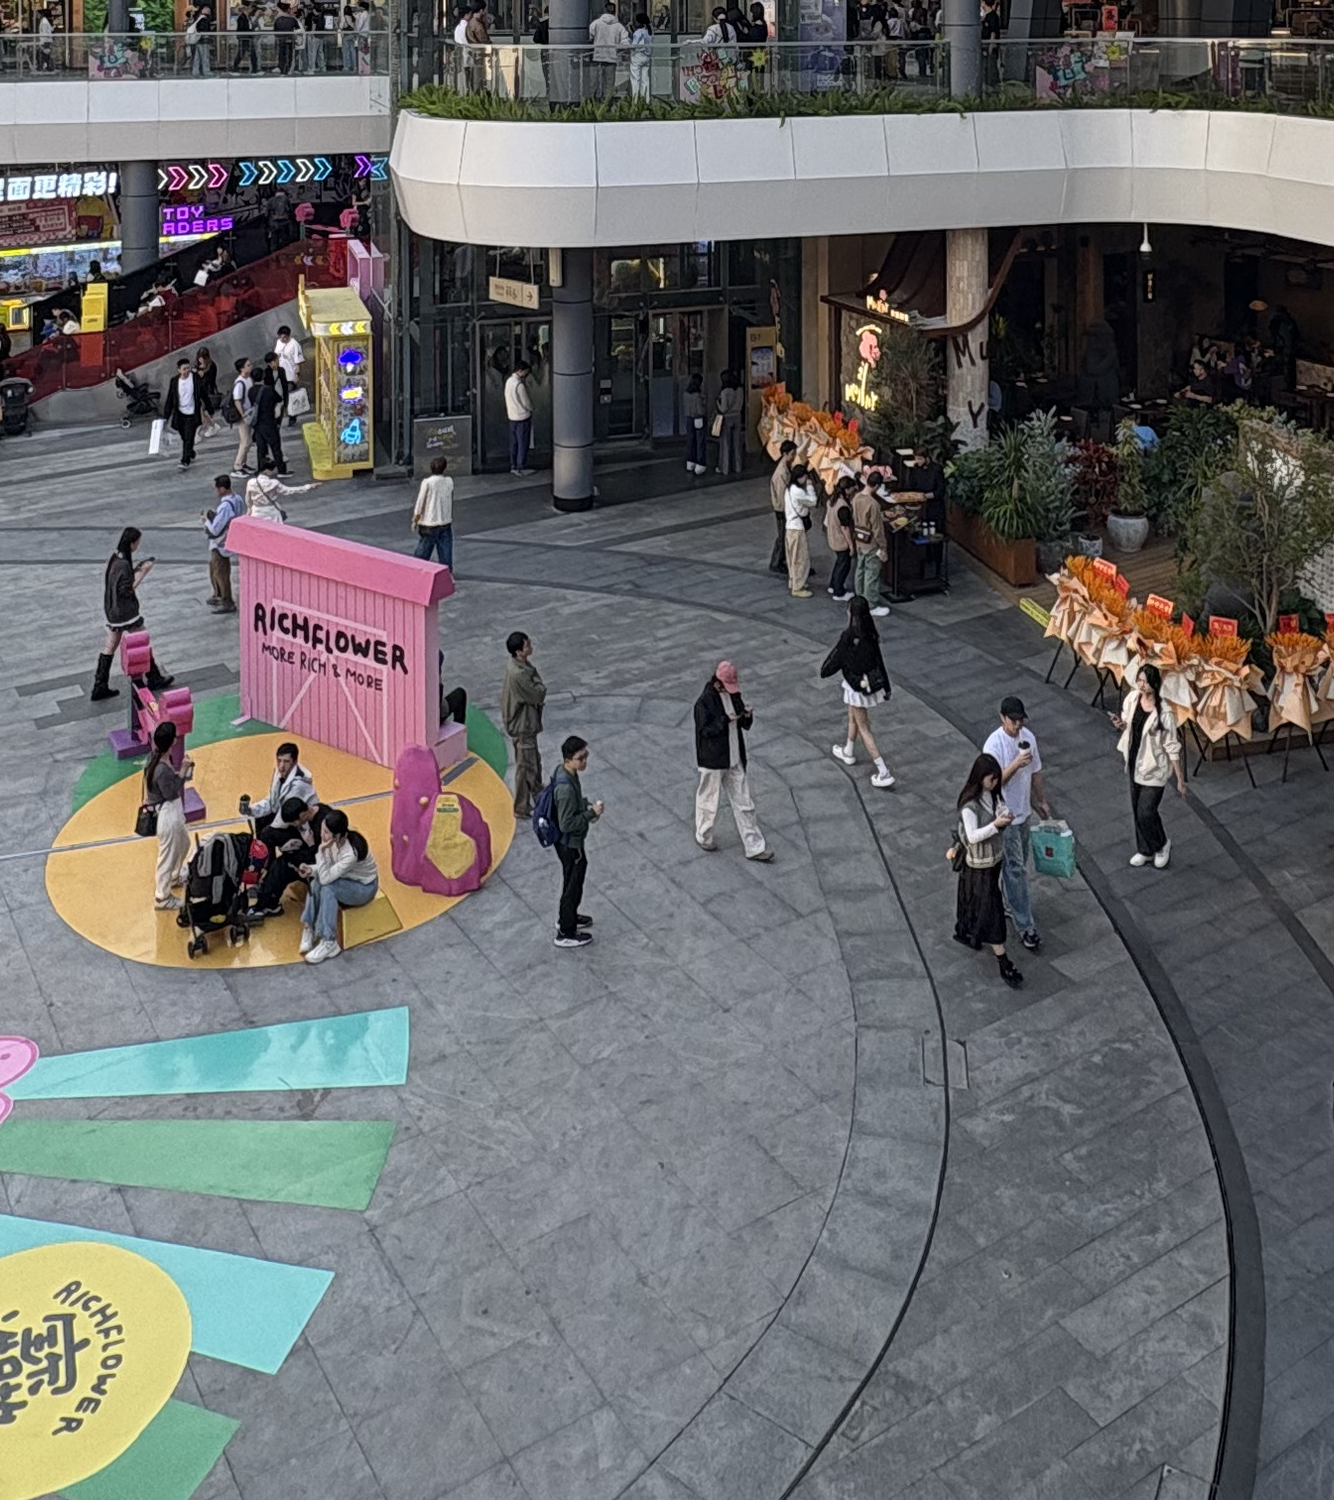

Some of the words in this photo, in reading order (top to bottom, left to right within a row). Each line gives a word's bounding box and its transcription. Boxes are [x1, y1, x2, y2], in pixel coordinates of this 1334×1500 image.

[162, 205, 205, 222] TOY
[253, 601, 409, 676] RICHFLOWER
[261, 642, 296, 665] MORE
[299, 651, 327, 677] RICH
[331, 663, 341, 678] &
[345, 668, 384, 692] MORE
[52, 1279, 126, 1437] RICHFLOWER
